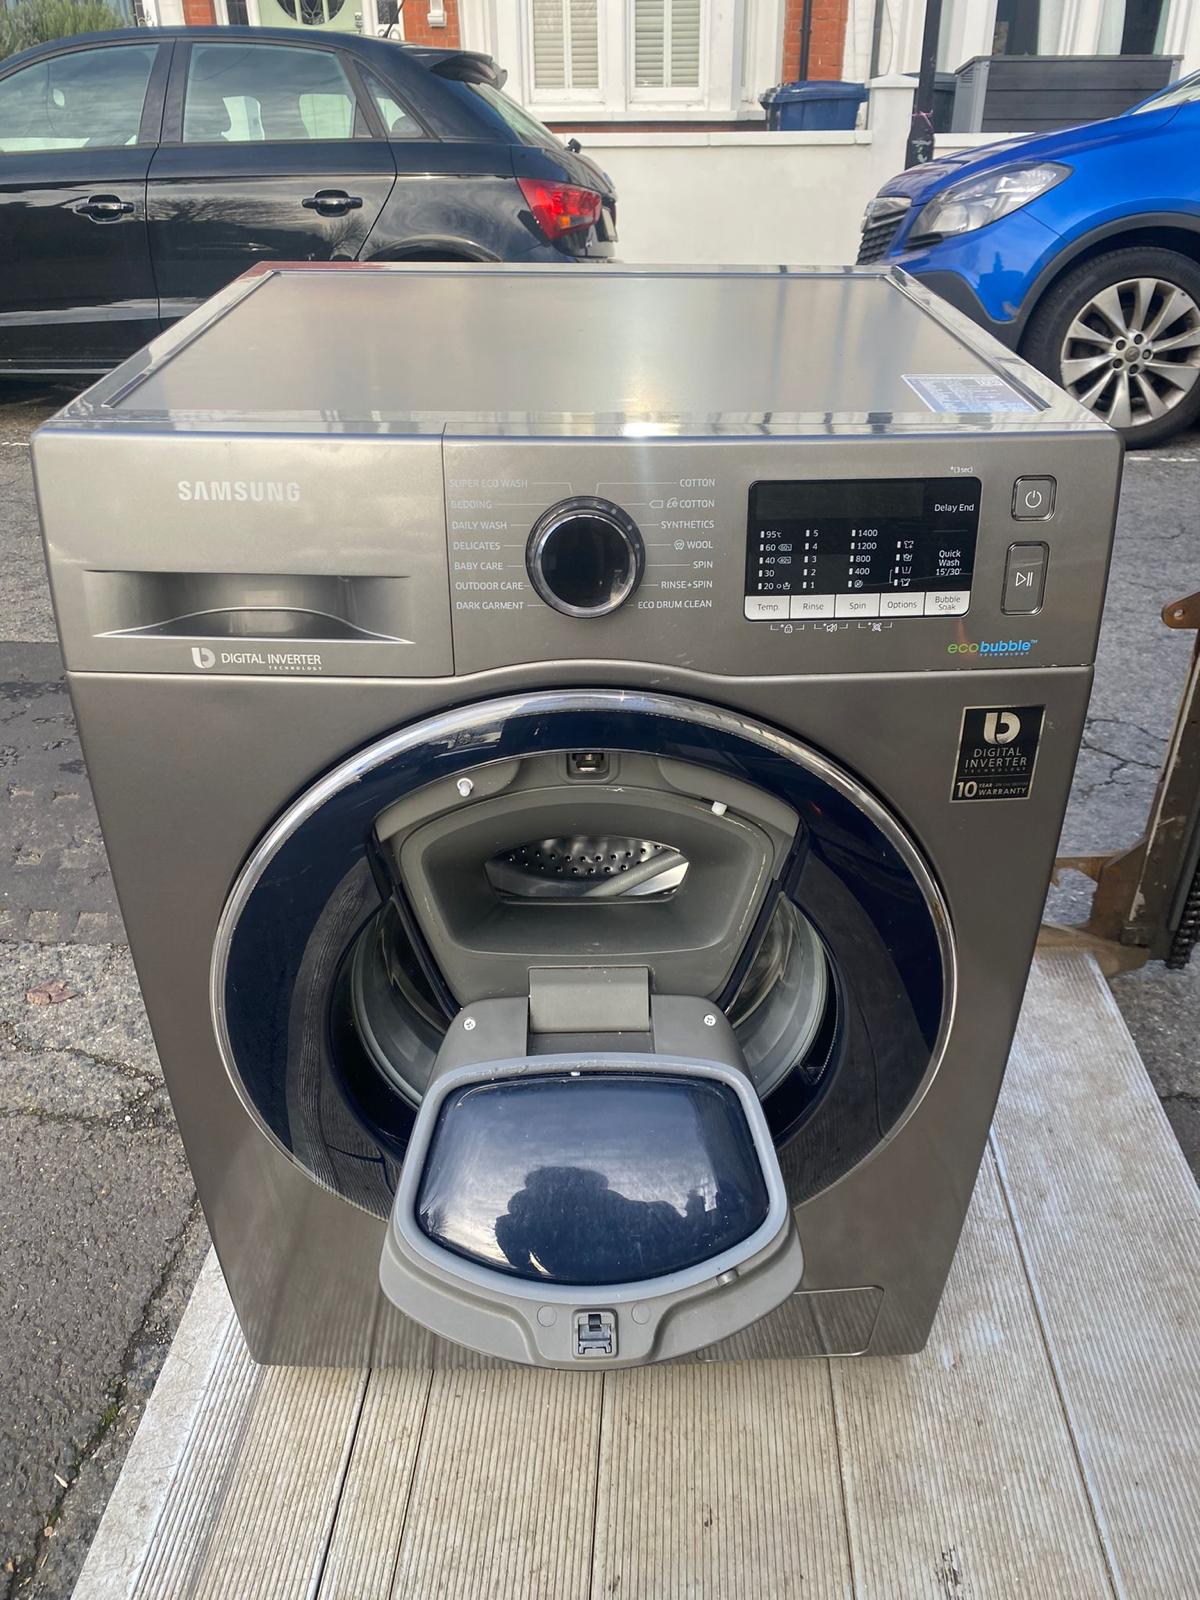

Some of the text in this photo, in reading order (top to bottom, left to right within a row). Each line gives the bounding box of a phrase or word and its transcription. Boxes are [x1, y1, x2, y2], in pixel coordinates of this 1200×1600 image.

[448, 479, 528, 488] SUPER ECO WASH
[680, 478, 715, 488] COTTON
[178, 480, 301, 501] SAMSUNG
[450, 500, 493, 509] BEDDING
[679, 499, 715, 509] COTTON
[934, 503, 975, 513] Delay End
[452, 520, 508, 530] DAILY WASH
[661, 520, 715, 529] SYNTHETICS
[812, 529, 819, 537] 5
[858, 529, 878, 537] 1400
[453, 541, 501, 551] DELICATES
[686, 540, 713, 549] WOOL
[857, 542, 877, 550] 1200
[938, 549, 961, 558] Quick
[811, 555, 817, 563] 3
[855, 555, 871, 563] 800
[938, 558, 960, 567] Wash
[454, 562, 504, 570] BABY CARE
[693, 560, 713, 569] SPIN
[854, 567, 870, 575] 400
[455, 581, 524, 590] OUTDOOR CARE
[763, 582, 774, 590] 20
[810, 581, 815, 589] 1
[638, 599, 712, 609] ECO DRUM CLEAN
[935, 595, 961, 604] Bubble
[456, 601, 524, 610] DARK GARMENT
[757, 603, 779, 612] Temp
[802, 602, 824, 611] Rinse
[849, 602, 867, 611] Spin
[887, 601, 918, 610] Options
[221, 652, 322, 665] DIGITAL INVERTER
[973, 747, 1022, 758] DIGITAL
[965, 757, 1027, 769] INVERTER
[956, 780, 978, 798] 10
[978, 787, 1027, 796] WARRANTY
